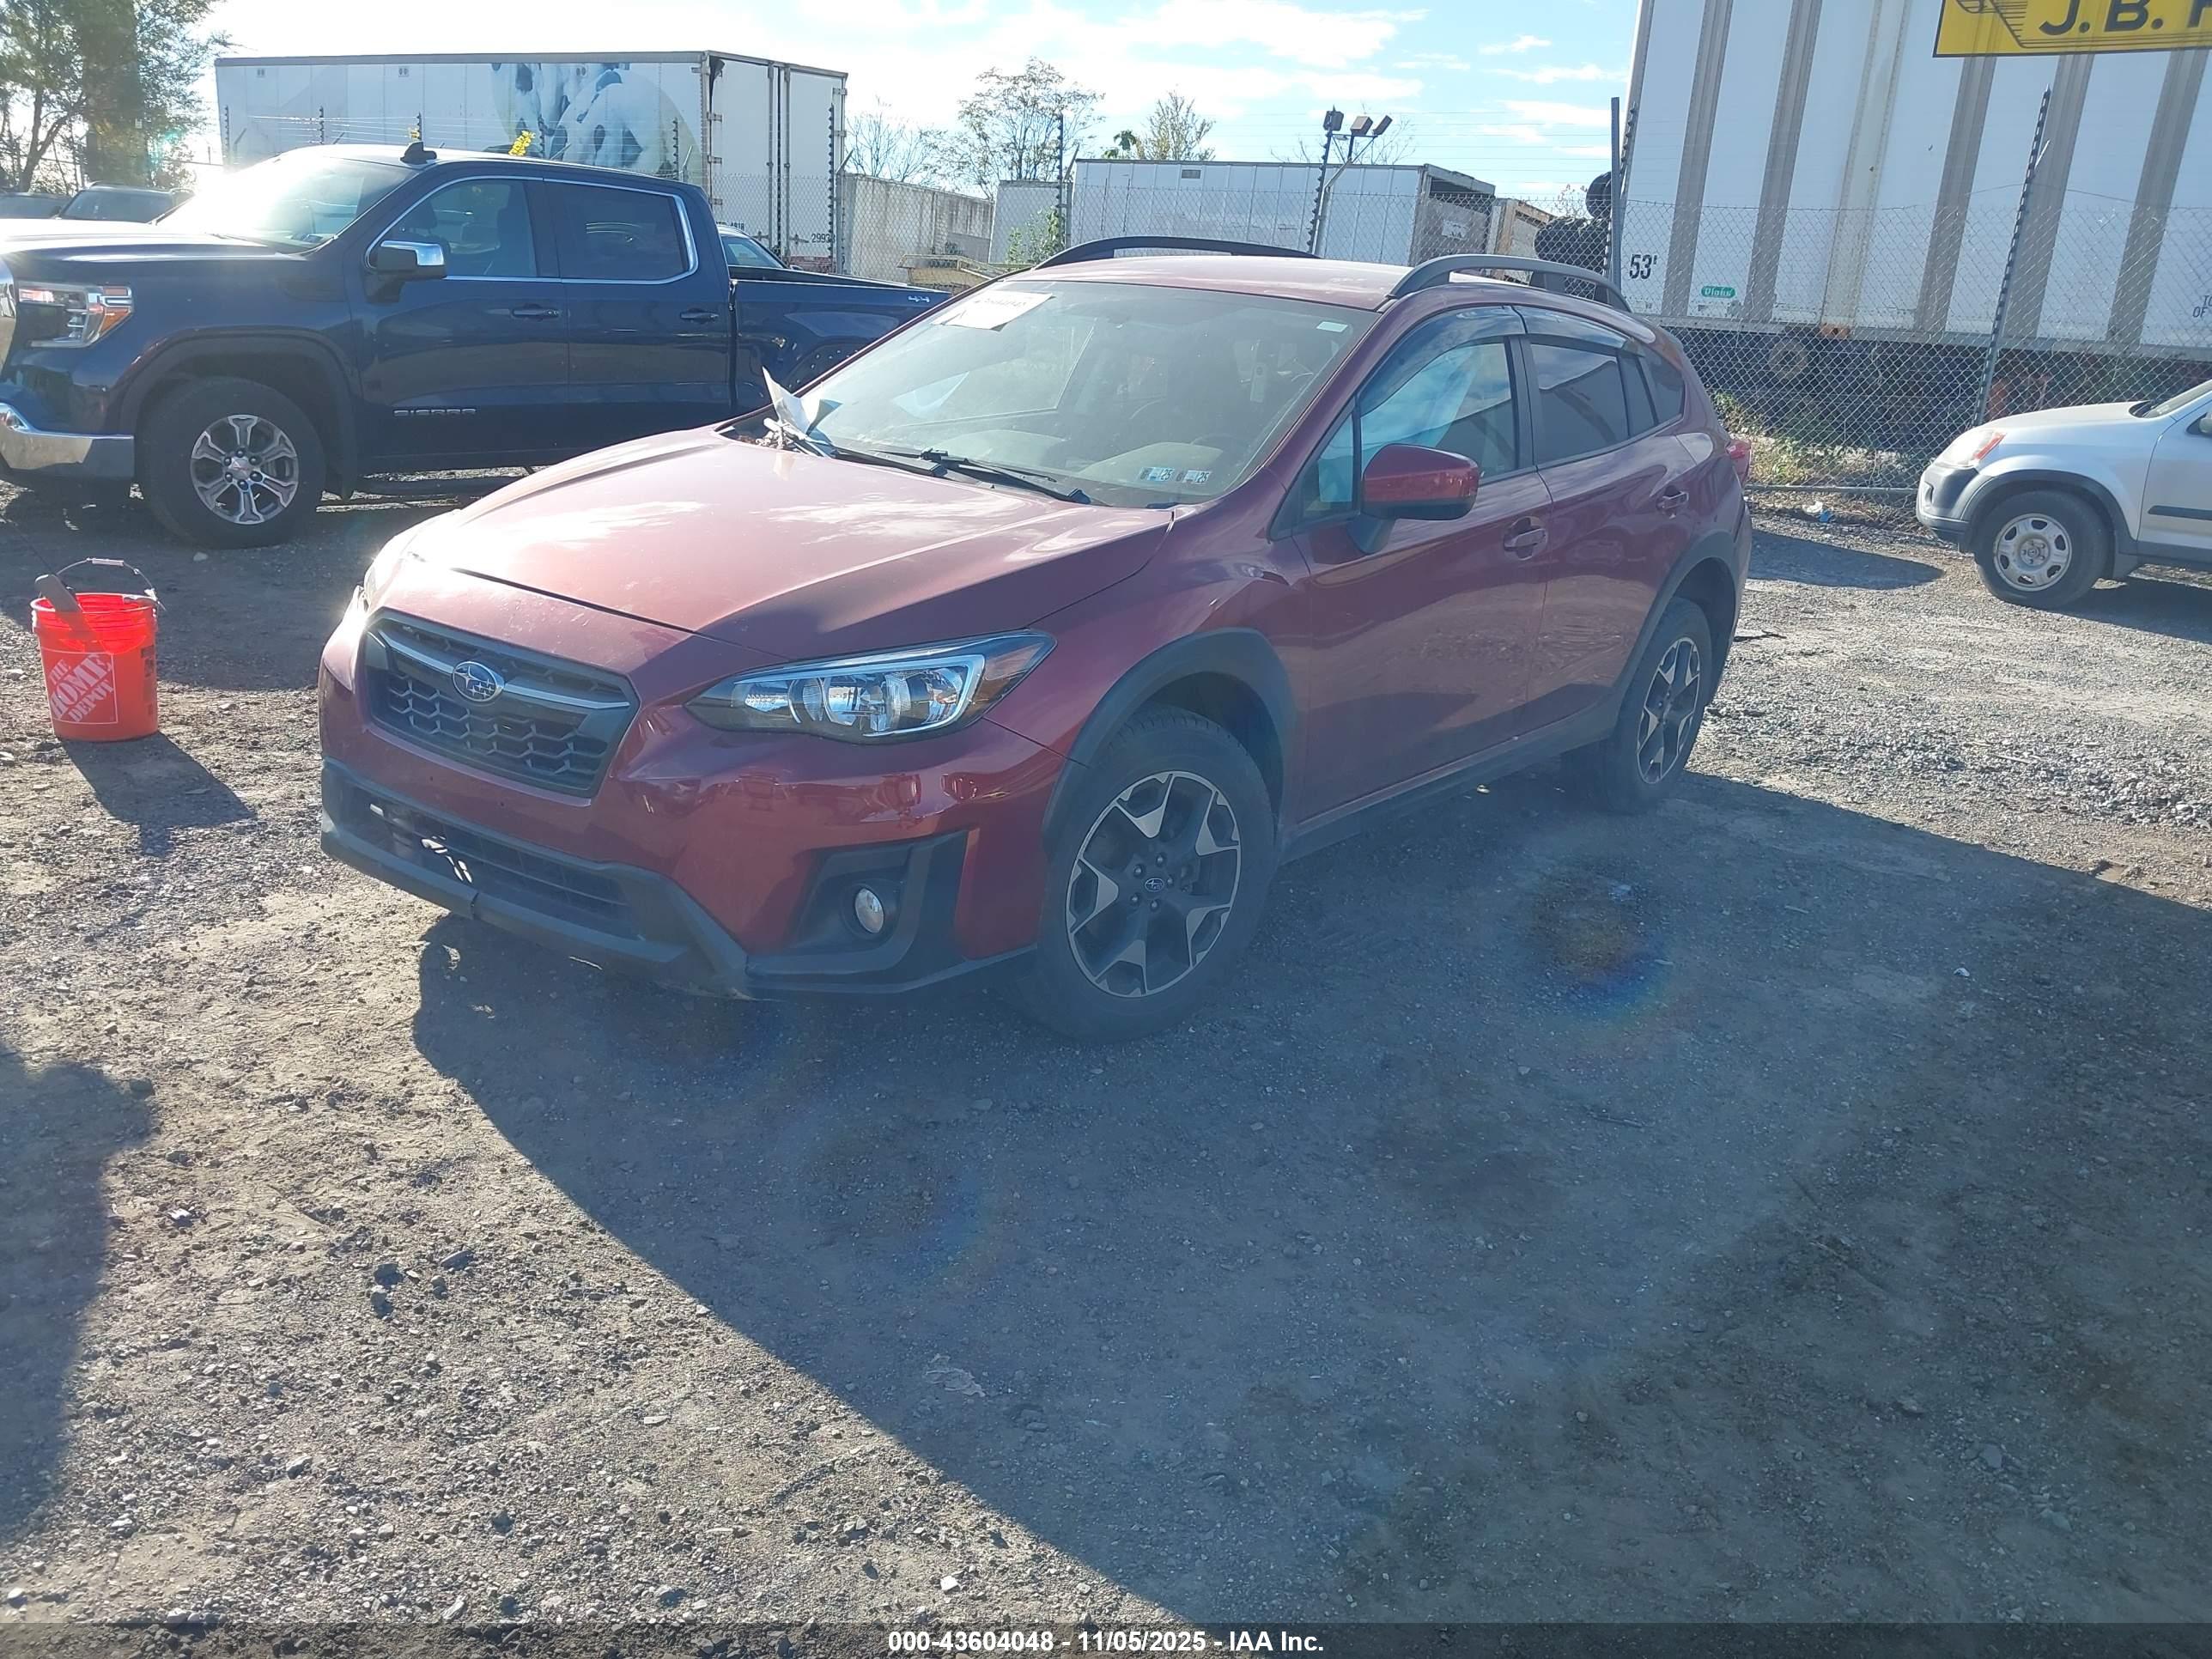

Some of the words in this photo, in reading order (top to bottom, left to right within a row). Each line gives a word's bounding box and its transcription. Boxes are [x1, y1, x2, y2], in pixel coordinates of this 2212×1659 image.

[1629, 253, 1657, 279] 53'
[2192, 306, 2209, 318] OF
[49, 659, 72, 685] THE
[51, 653, 112, 720] HOME
[68, 679, 114, 722] DEPOT
